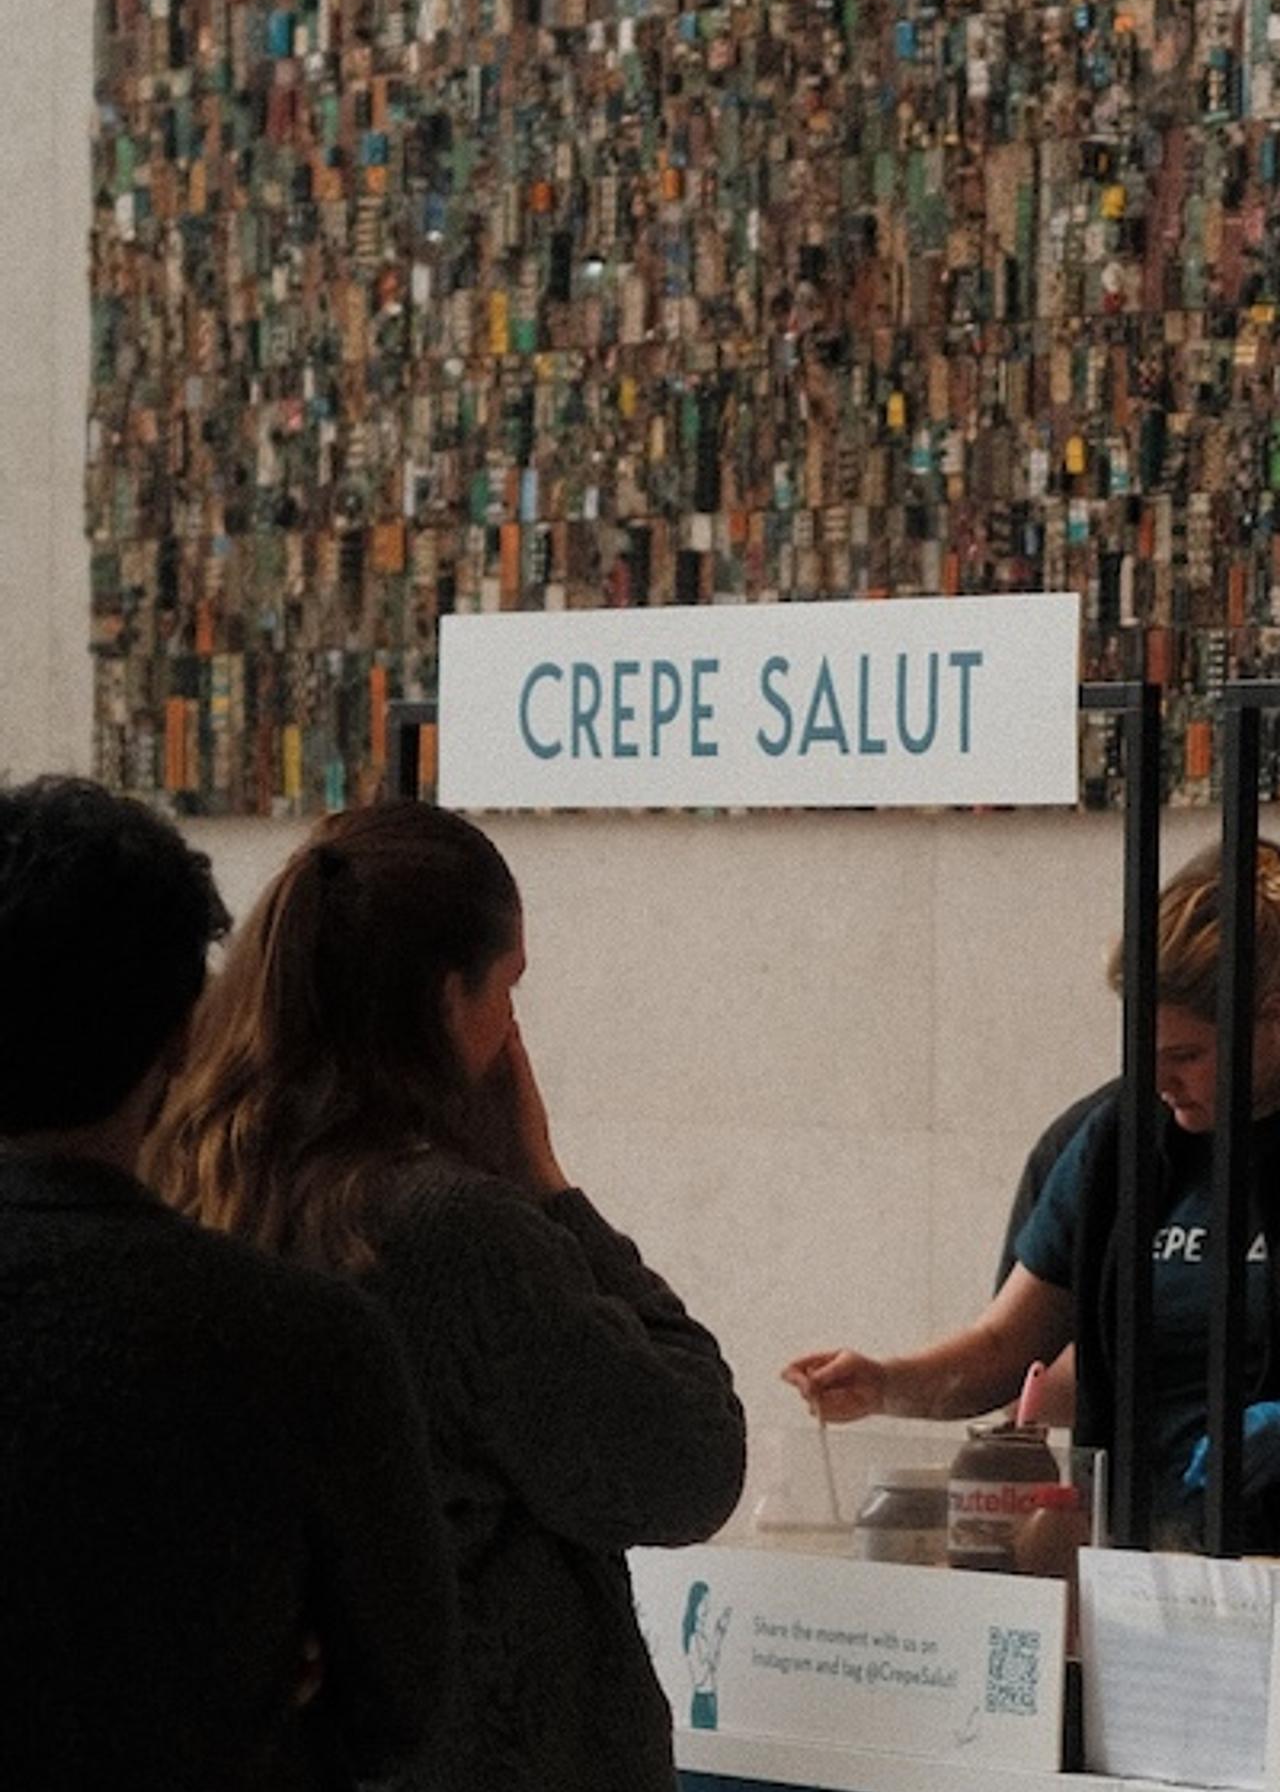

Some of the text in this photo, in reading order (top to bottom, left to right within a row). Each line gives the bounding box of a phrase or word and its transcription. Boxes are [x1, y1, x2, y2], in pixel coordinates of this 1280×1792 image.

[519, 651, 983, 760] CREPE SALUT
[1151, 1226, 1208, 1262] EPE
[753, 1615, 939, 1655] Share the moment with us on
[752, 1648, 812, 1675] Instagram
[816, 1655, 840, 1676] and
[842, 1660, 863, 1684] tag
